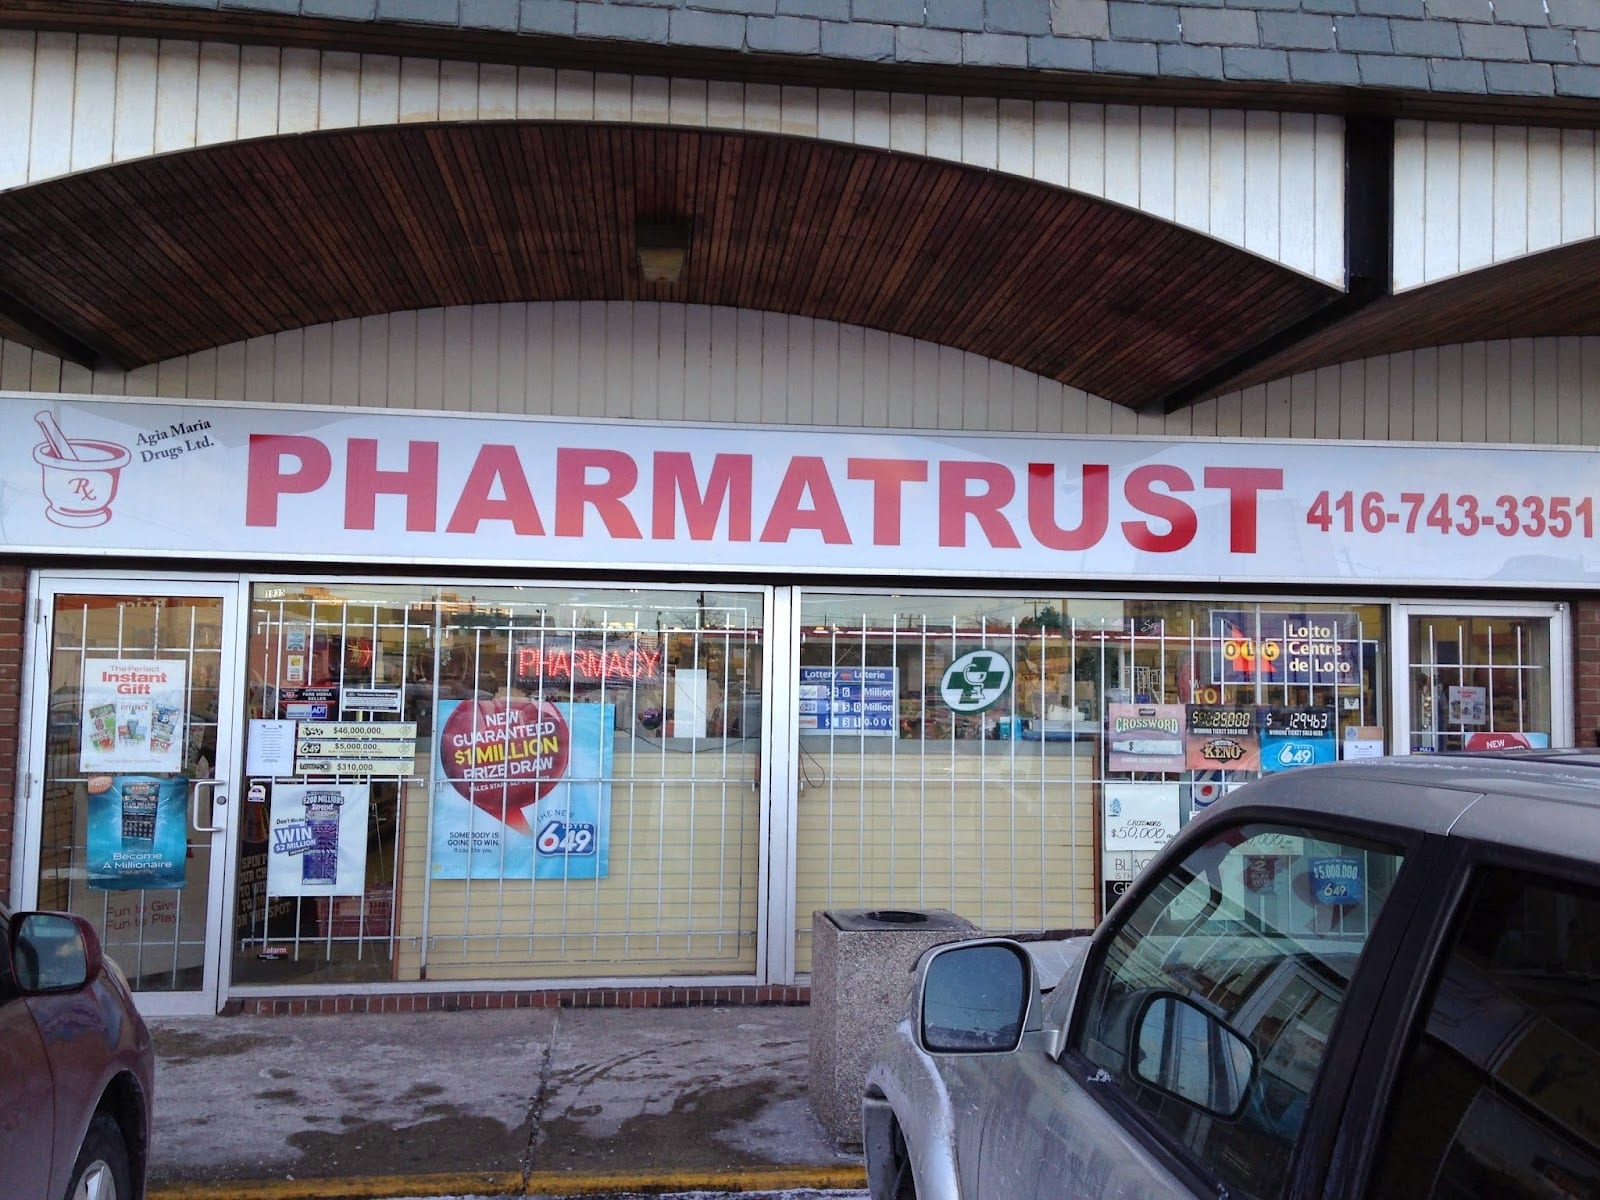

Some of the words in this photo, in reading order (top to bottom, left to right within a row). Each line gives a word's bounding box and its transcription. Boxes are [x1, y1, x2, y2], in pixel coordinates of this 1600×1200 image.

[136, 429, 168, 446] Agia
[169, 420, 212, 437] Maria
[140, 446, 183, 463] Drugs
[185, 435, 214, 452] Ltd.
[245, 433, 1284, 553] PHARMATRUST
[1306, 490, 1594, 538] 416-743-3351
[1288, 624, 1331, 638] Lotto
[1288, 642, 1342, 656] Centre
[128, 665, 160, 673] Perfect
[519, 649, 659, 678] PHARMACY
[1289, 658, 1309, 672] de
[1315, 658, 1351, 673] Loto
[102, 671, 167, 683] Instant
[804, 670, 838, 680] Lottery
[117, 683, 151, 695] Gift
[312, 706, 326, 714] ADT
[485, 711, 519, 727] NEW
[1115, 717, 1178, 735] CROSSWORD
[453, 722, 556, 747] GUARANTEED
[301, 743, 320, 754] 649
[454, 748, 473, 766] $1
[476, 736, 559, 764] MILLION
[1486, 740, 1505, 749] NEW
[1204, 745, 1241, 759] KENO
[463, 765, 506, 780] PRIZE
[510, 757, 553, 775] DRAW
[277, 827, 312, 844] WIN
[538, 823, 592, 852] 649
[286, 839, 316, 850] MILLION
[113, 852, 162, 860] Become
[114, 861, 172, 869] Millionaire
[1115, 858, 1152, 873] BLAC
[1323, 883, 1346, 896] 649
[107, 906, 131, 917] Fun
[151, 900, 178, 911] Give
[106, 920, 130, 930] Fun
